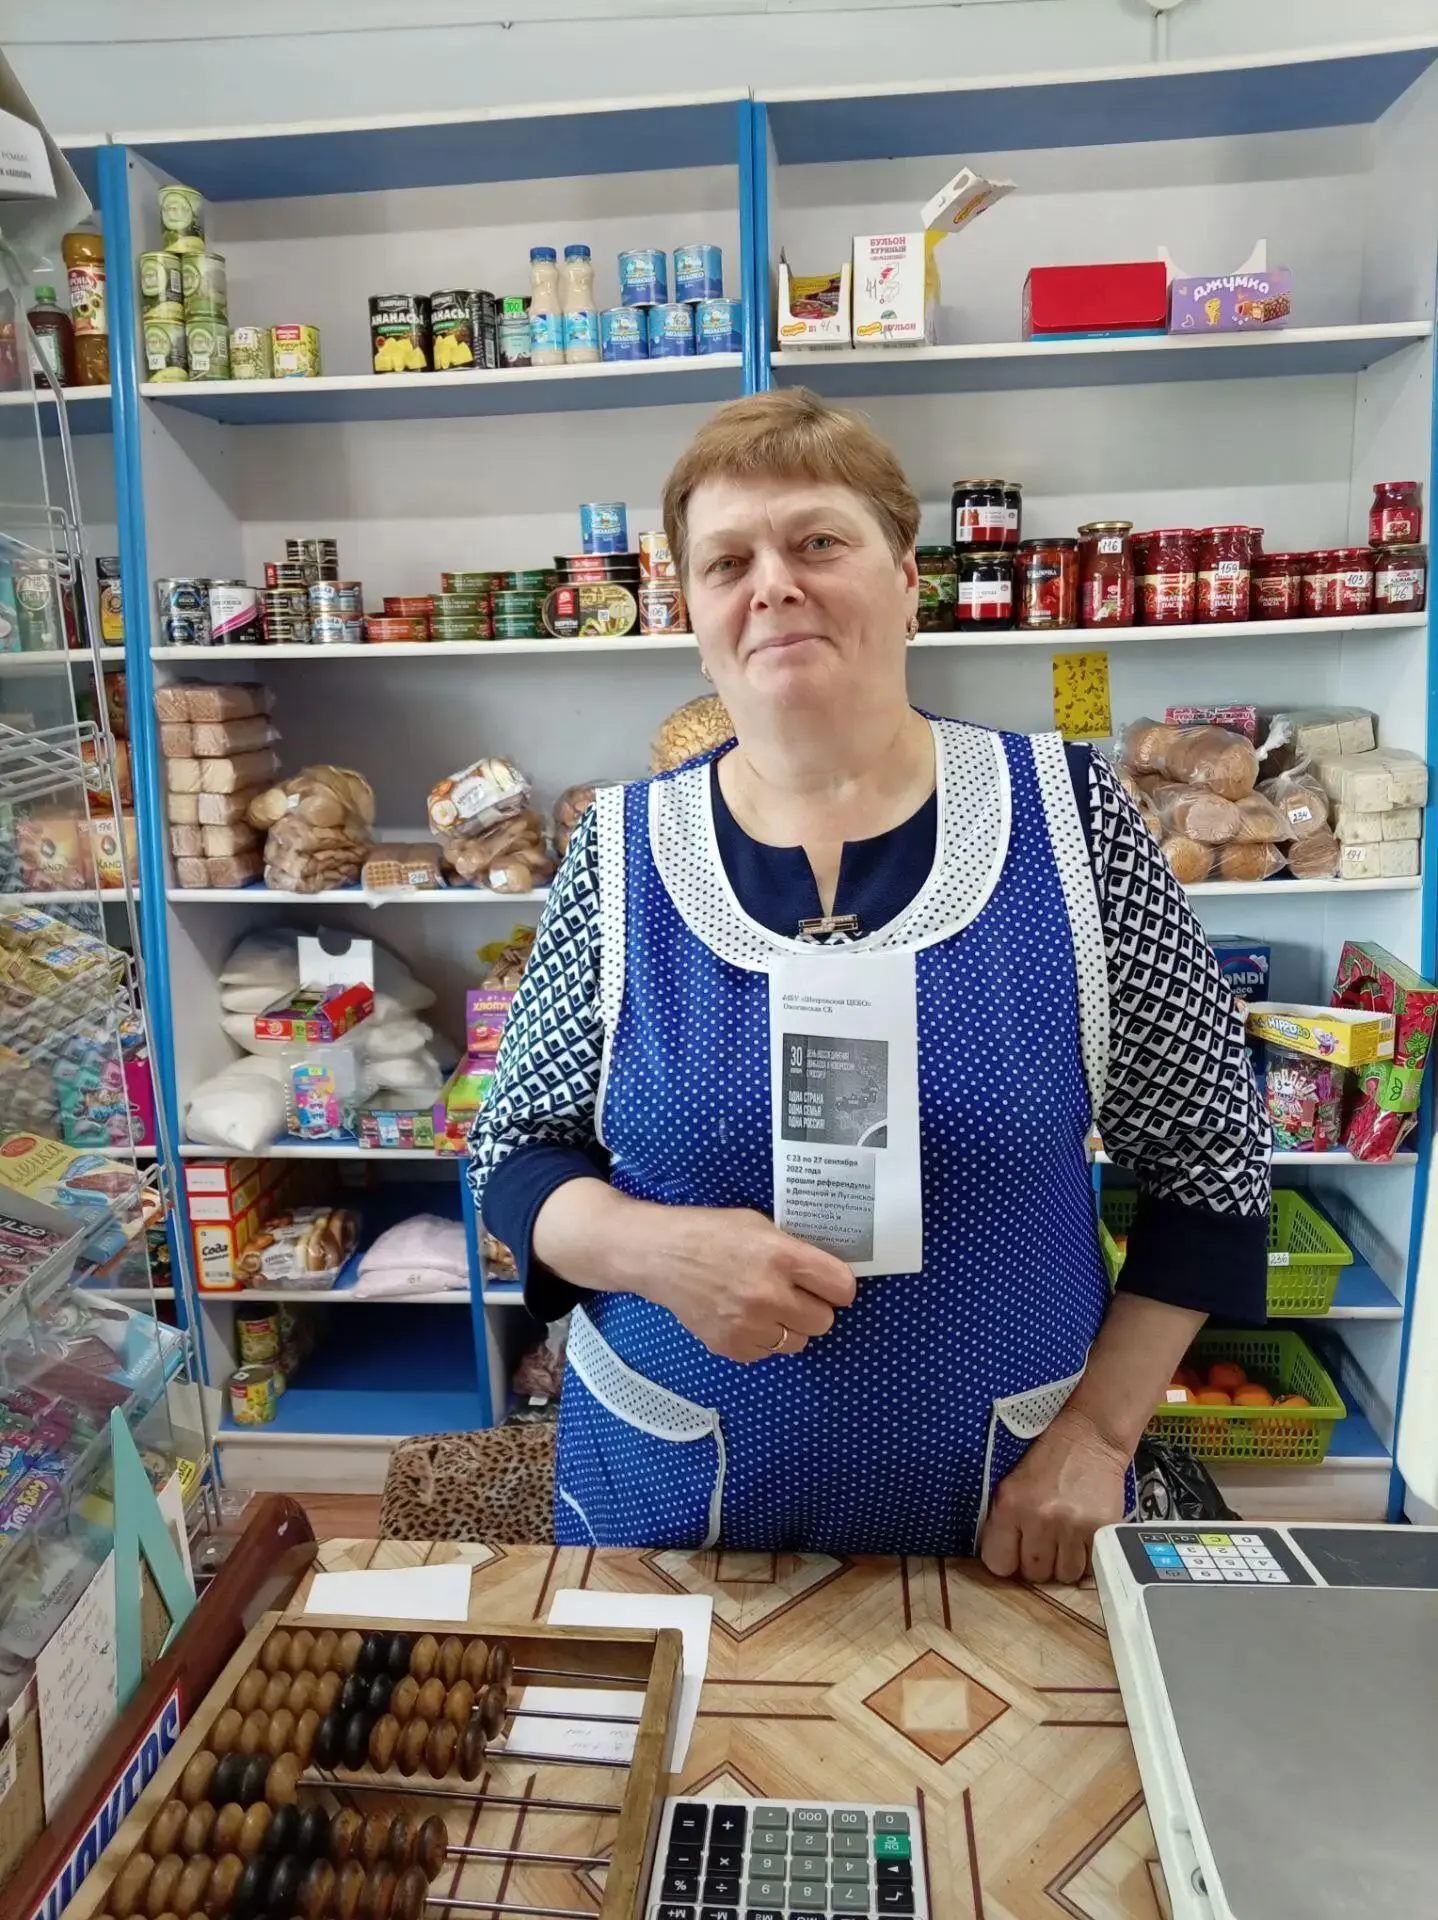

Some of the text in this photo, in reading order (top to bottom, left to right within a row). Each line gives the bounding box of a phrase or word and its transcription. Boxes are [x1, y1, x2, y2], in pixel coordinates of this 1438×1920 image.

[870, 237, 906, 246] БУЛЬОН
[1348, 574, 1364, 586] 103
[790, 1046, 803, 1067] 30
[824, 1158, 858, 1167] сентября
[786, 1165, 803, 1173] 2022
[816, 1179, 872, 1190] референдумы
[792, 1188, 829, 1197] Донецкой
[786, 1199, 822, 1208] народных
[798, 1812, 822, 1822] 000
[841, 1813, 858, 1824] 00
[886, 1814, 894, 1824] 0
[765, 1832, 774, 1843] 3
[806, 1835, 814, 1845] 2
[846, 1836, 852, 1846] 1
[762, 1858, 772, 1868] 6
[804, 1860, 812, 1870] 5
[845, 1862, 854, 1872] 4
[761, 1884, 771, 1894] 9
[803, 1886, 812, 1896] 8
[844, 1888, 854, 1899] 7
